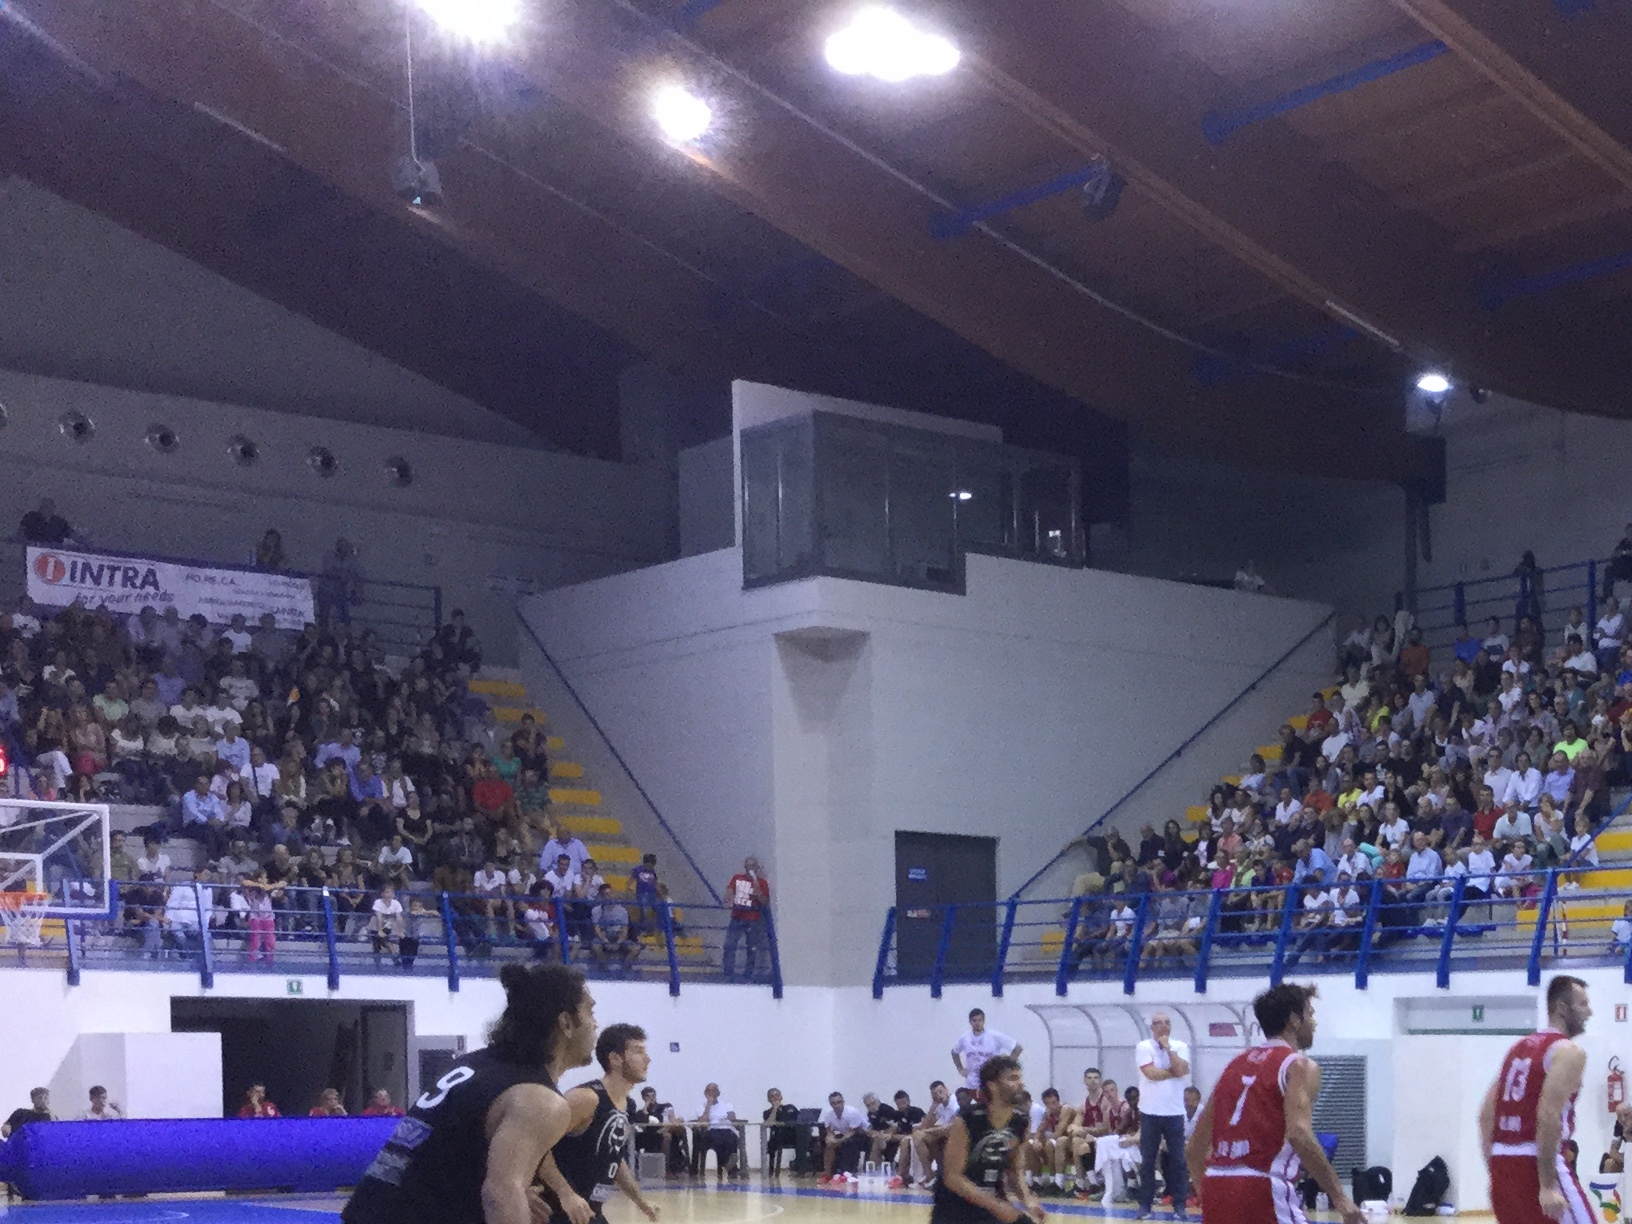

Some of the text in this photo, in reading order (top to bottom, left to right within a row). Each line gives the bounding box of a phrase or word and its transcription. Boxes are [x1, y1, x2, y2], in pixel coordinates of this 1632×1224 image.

[69, 560, 160, 591] INTRA
[100, 593, 132, 605] your
[134, 588, 175, 603] needs
[416, 1066, 475, 1109] 9
[1229, 1075, 1257, 1126] 7
